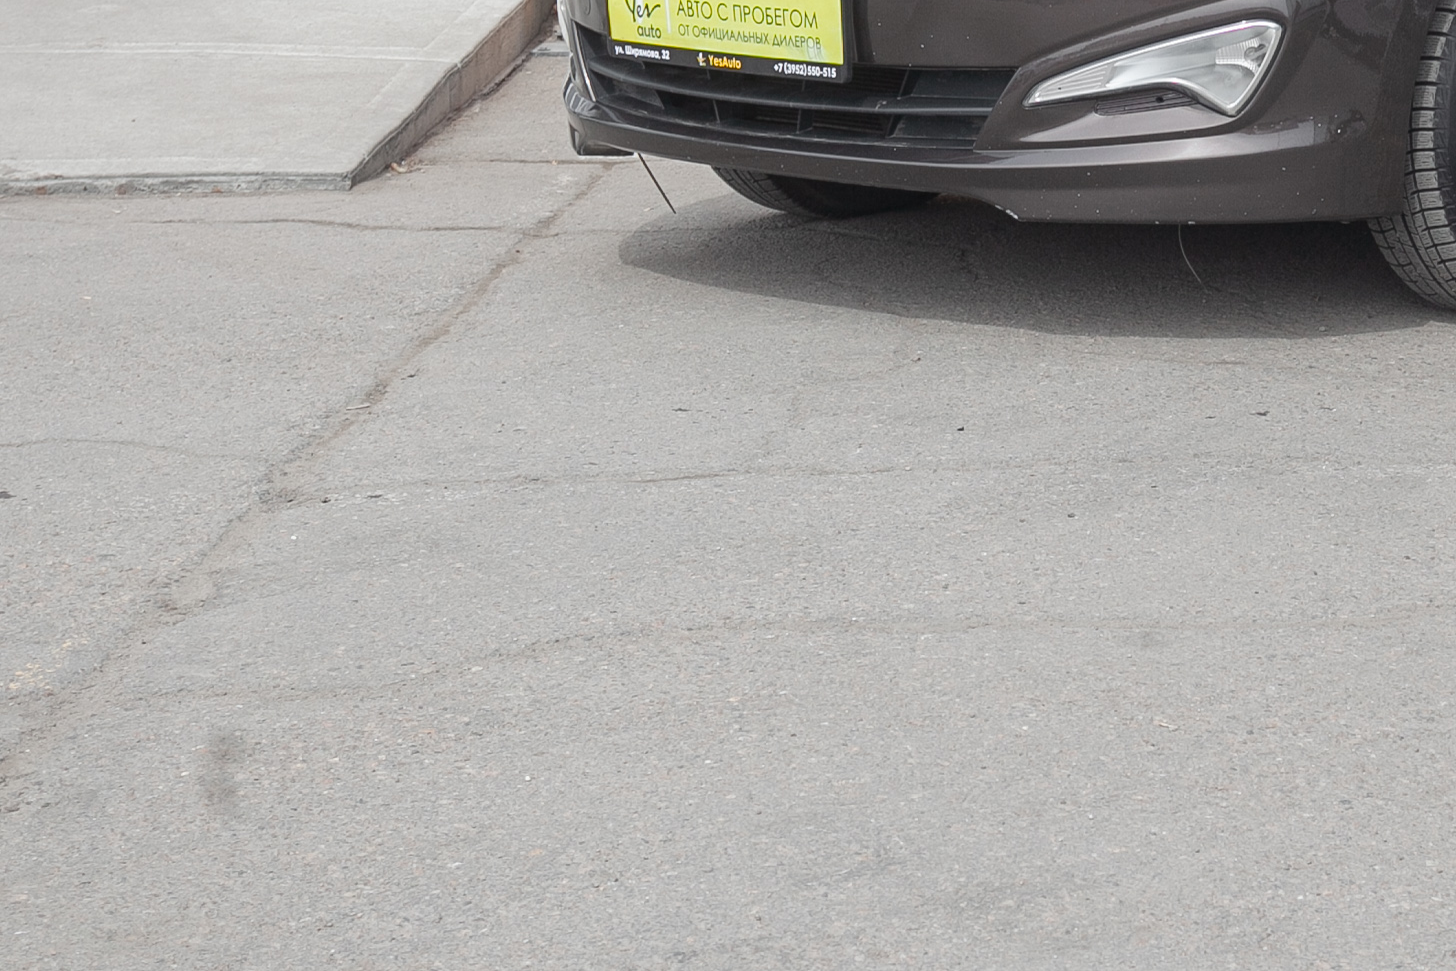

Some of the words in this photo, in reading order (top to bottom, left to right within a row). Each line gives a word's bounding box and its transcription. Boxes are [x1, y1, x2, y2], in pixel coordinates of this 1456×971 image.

[676, 0, 713, 20] АВТО
[717, 2, 728, 21] С
[732, 4, 819, 29] ПРОБЕГОМ
[637, 24, 662, 39] auto
[678, 23, 689, 38] ОТ
[691, 24, 770, 45] ОФИЦИАЛЬНЫХ
[772, 33, 821, 50] ДИЛЕРОВ
[661, 50, 670, 60] 32
[708, 55, 742, 70] YesAuto
[773, 63, 784, 73] +7
